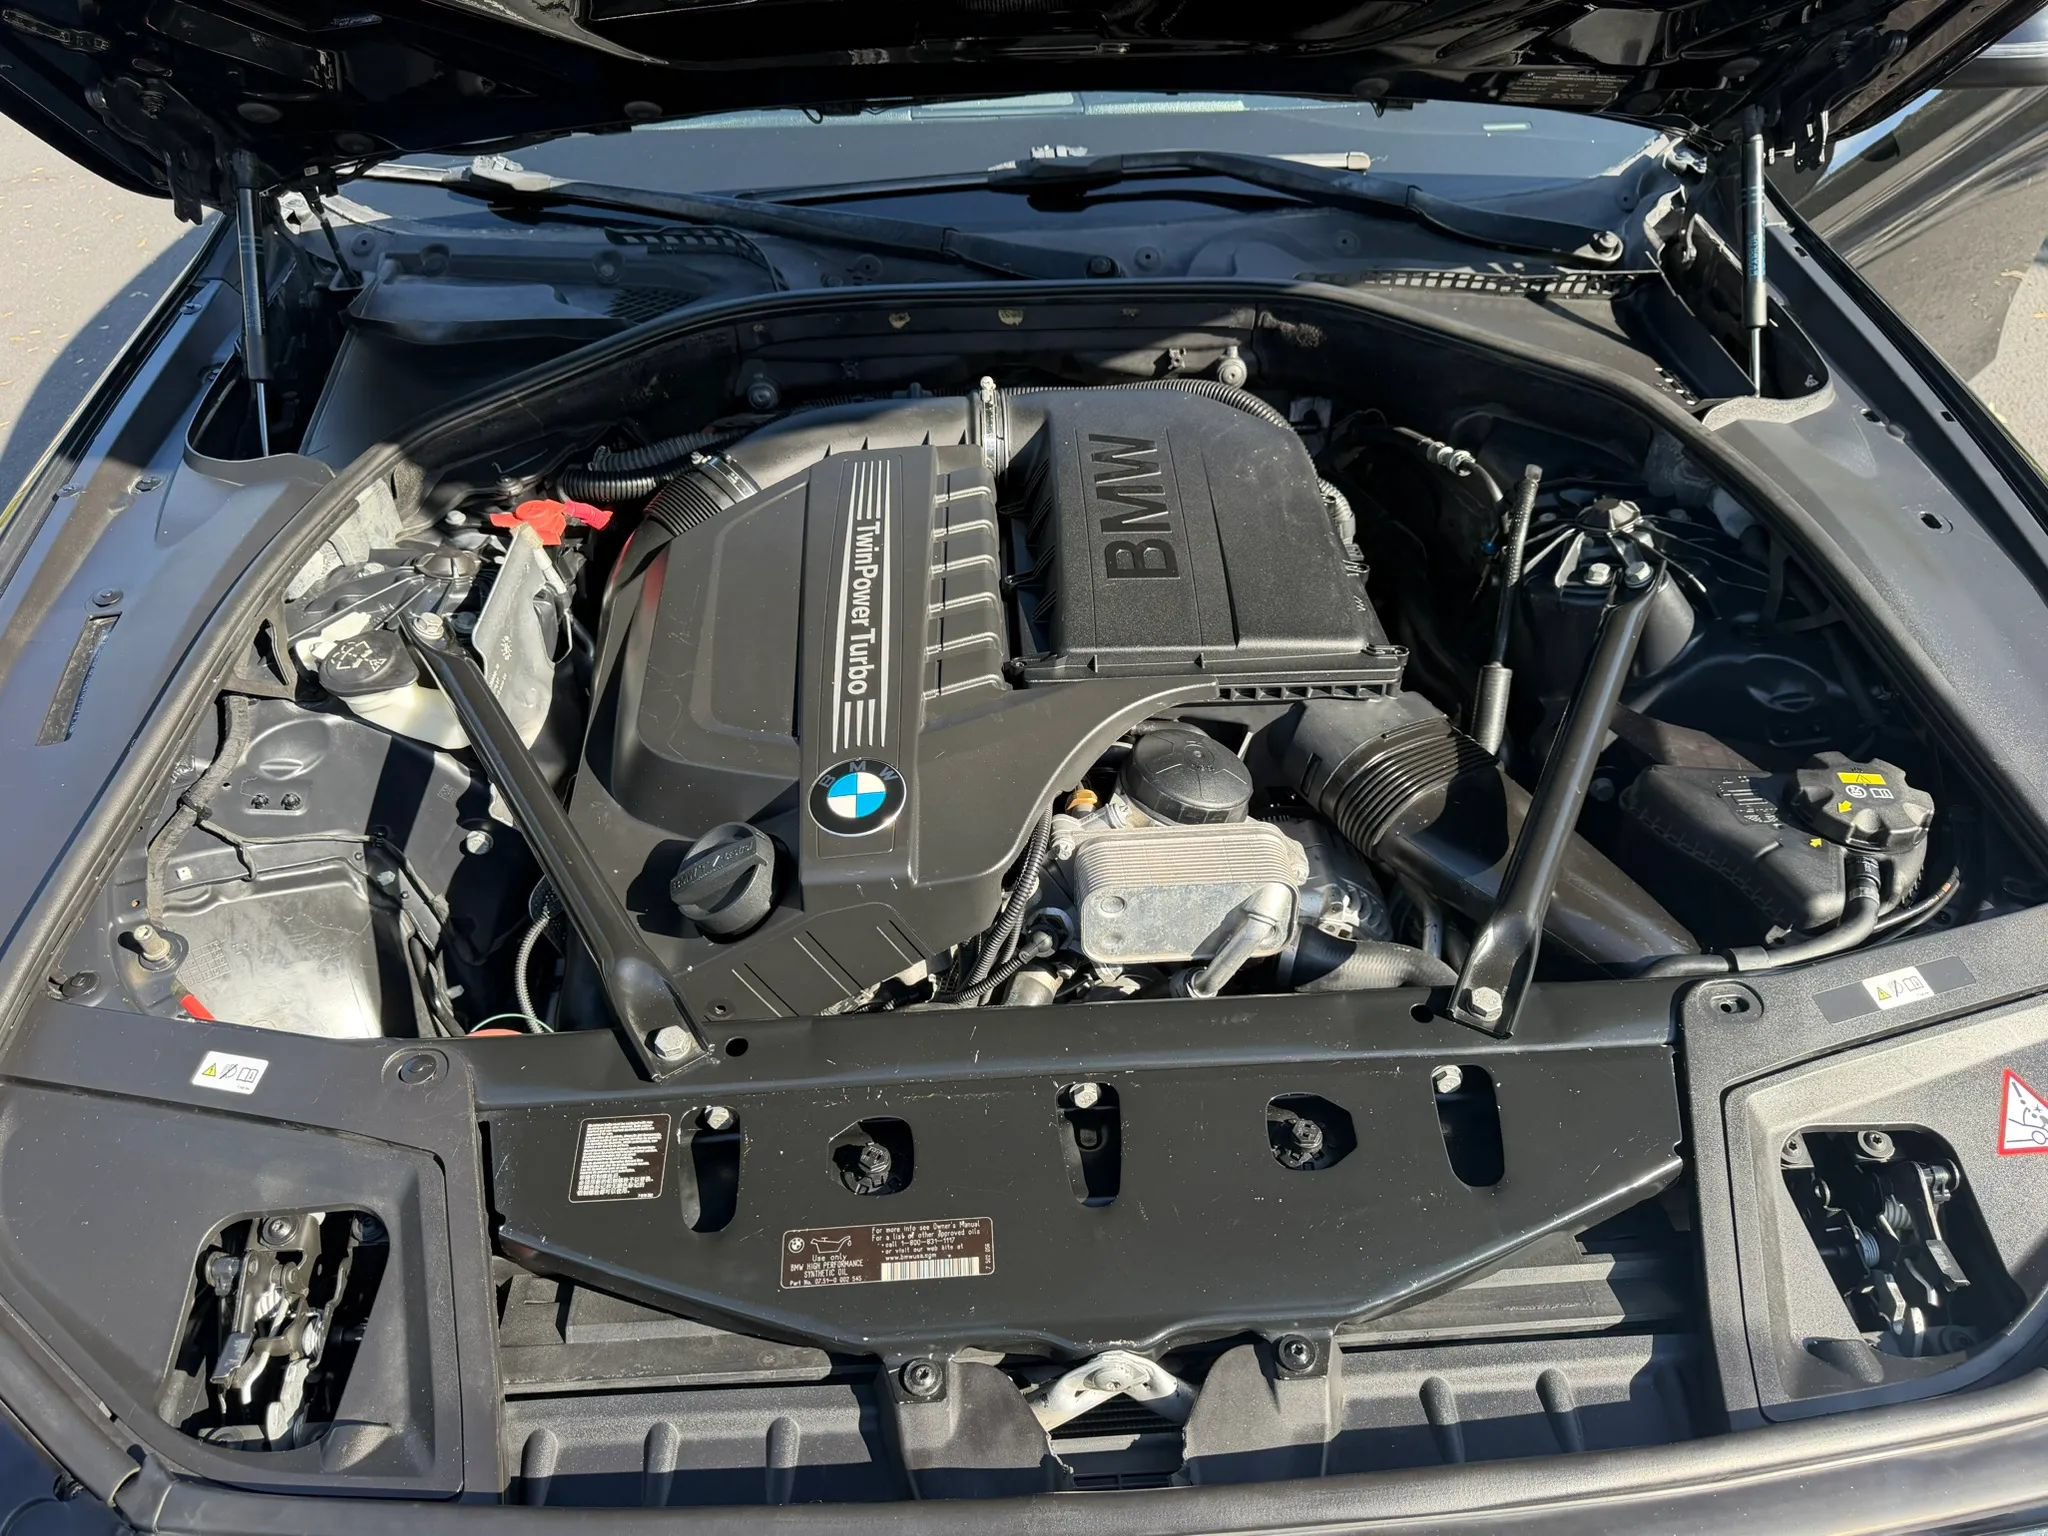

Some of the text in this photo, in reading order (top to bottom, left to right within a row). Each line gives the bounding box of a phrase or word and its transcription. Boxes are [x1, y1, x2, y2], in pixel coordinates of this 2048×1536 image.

[1088, 433, 1180, 580] BMW
[847, 521, 881, 696] TwinPower Turbo
[819, 759, 899, 788] BMW
[933, 1222, 956, 1230] Owner's
[959, 1220, 980, 1228] Manual
[937, 1229, 965, 1238] Approved
[830, 1253, 848, 1261] only
[790, 1259, 864, 1272] BMW HIGH PERFORMANCE
[804, 1268, 848, 1278] SYNTHETIC OIL
